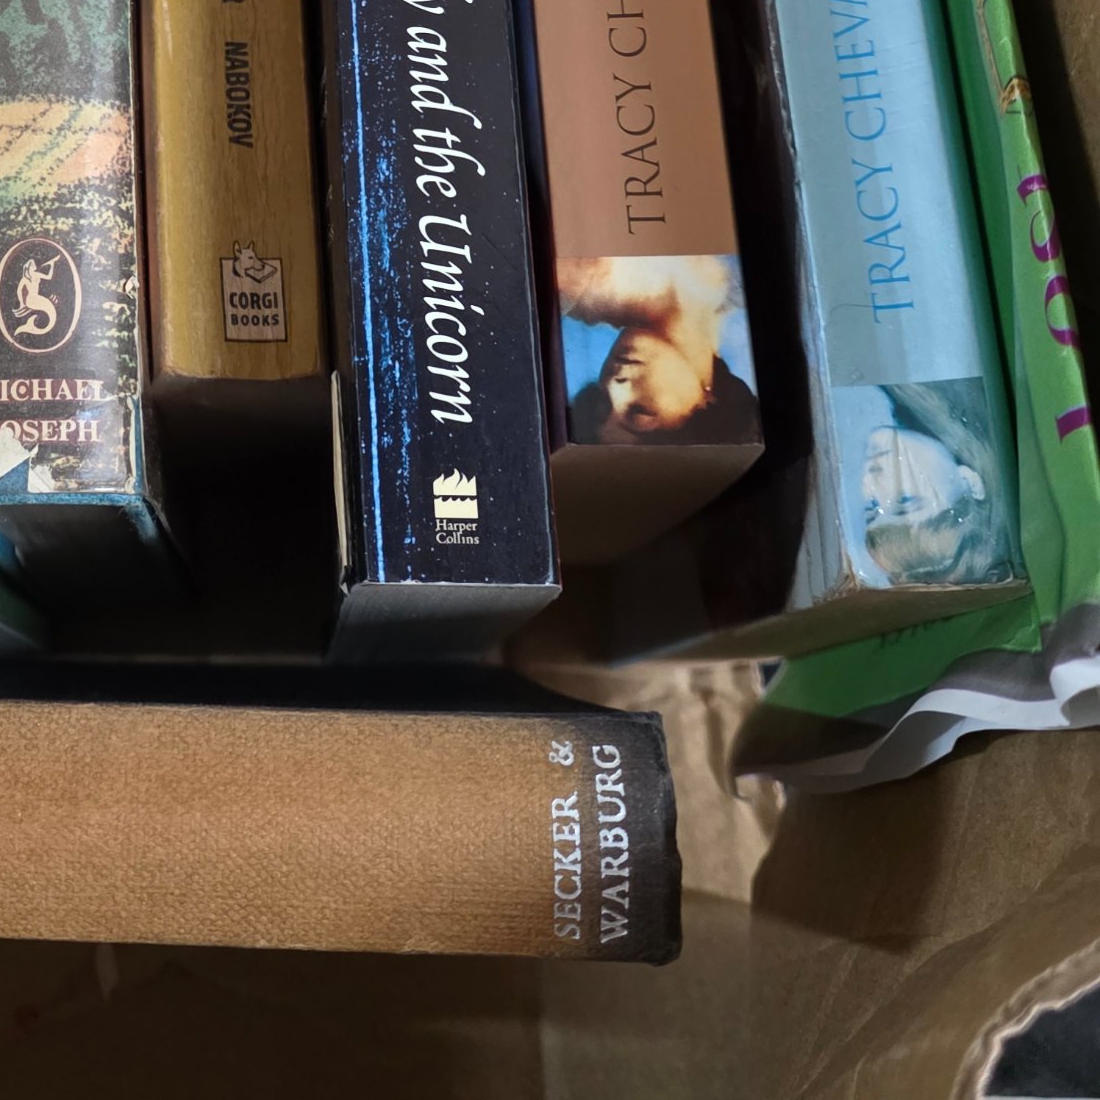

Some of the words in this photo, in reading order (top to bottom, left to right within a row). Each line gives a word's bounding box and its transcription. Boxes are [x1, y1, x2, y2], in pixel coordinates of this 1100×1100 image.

[224, 41, 254, 149] NABOKOV
[406, 26, 483, 130] and
[406, 129, 486, 200] the
[613, 73, 667, 235] TRACY
[852, 157, 916, 324] TRACY
[229, 292, 278, 310] CORGI
[230, 313, 279, 326] BOOKS
[417, 213, 485, 426] Unicorn
[435, 519, 478, 535] Harper
[435, 532, 480, 546] Collins
[548, 740, 575, 766] &
[551, 790, 582, 941] SECKER
[591, 743, 630, 945] WARBURG
